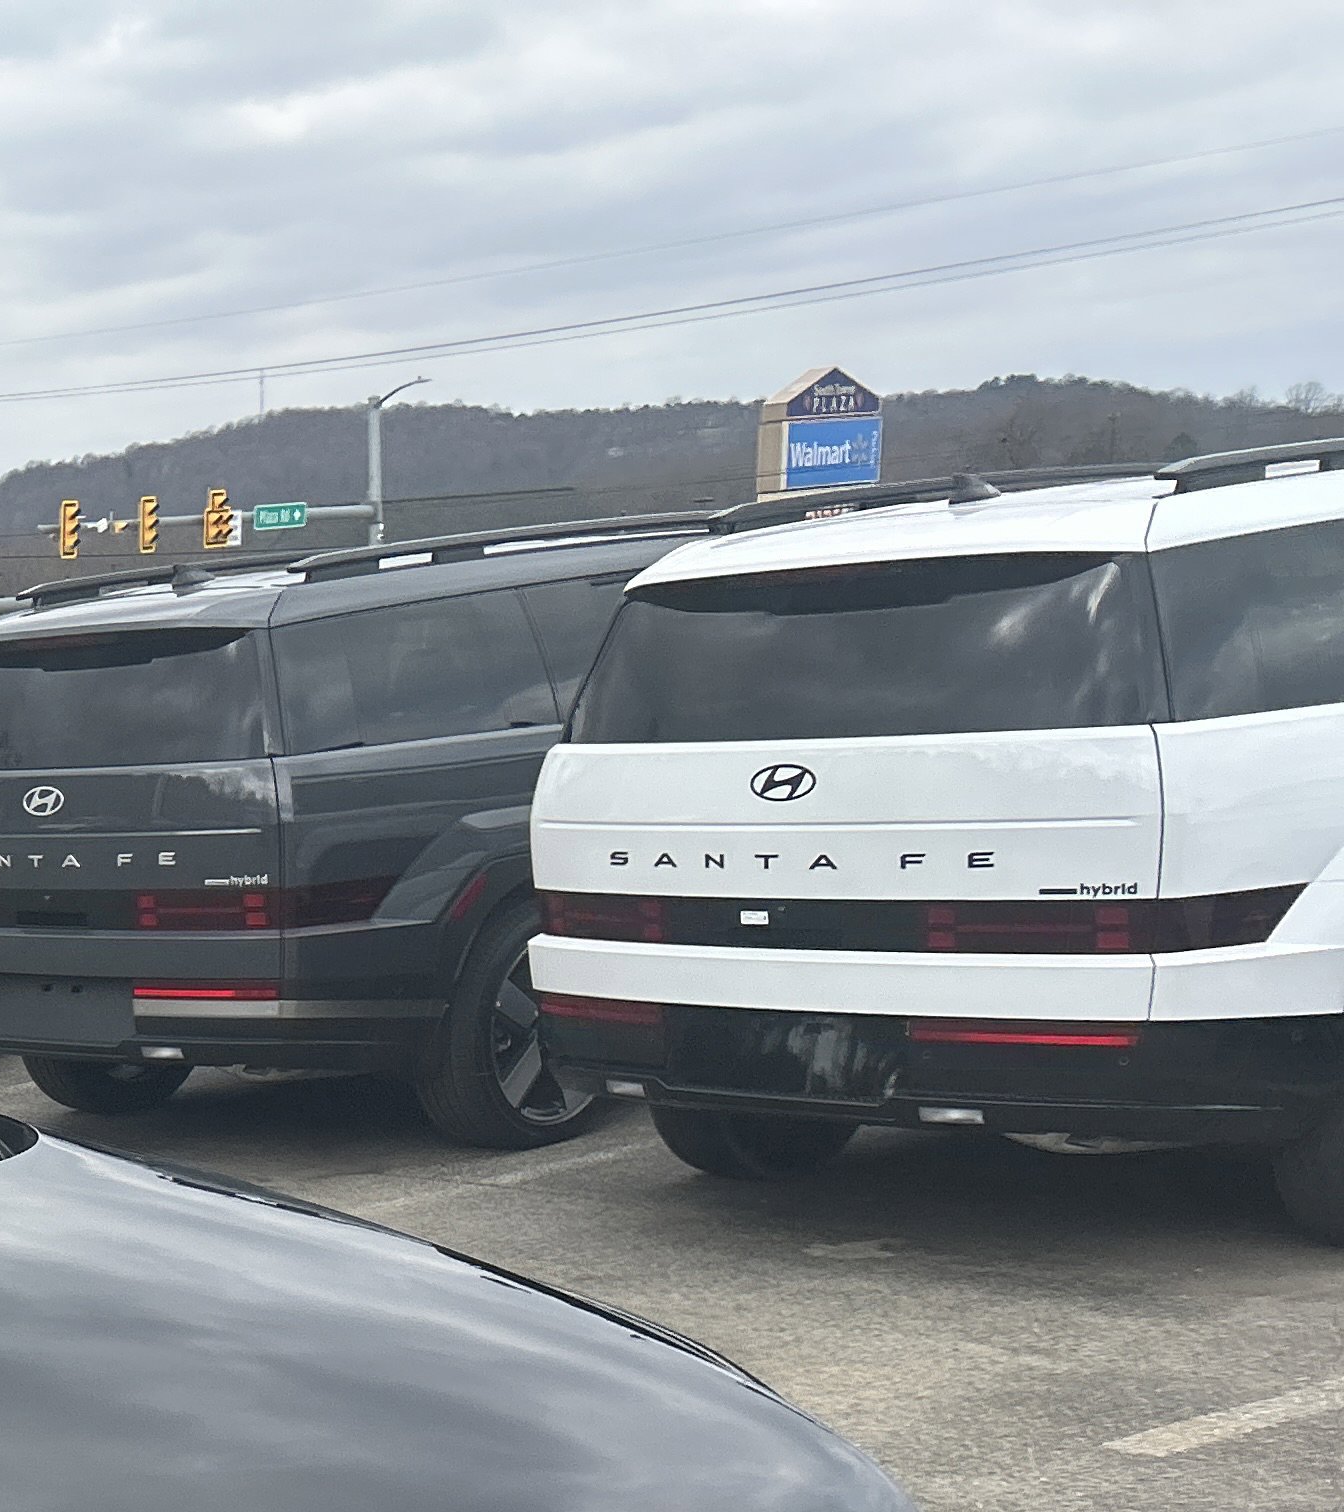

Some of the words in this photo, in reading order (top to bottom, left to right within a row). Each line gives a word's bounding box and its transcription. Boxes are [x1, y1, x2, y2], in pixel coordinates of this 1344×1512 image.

[790, 439, 852, 468] Walmart
[116, 851, 176, 867] FE
[609, 850, 839, 871] SANTA
[899, 850, 996, 870] FE
[229, 873, 269, 888] hybrid
[1080, 881, 1138, 897] hybrid
